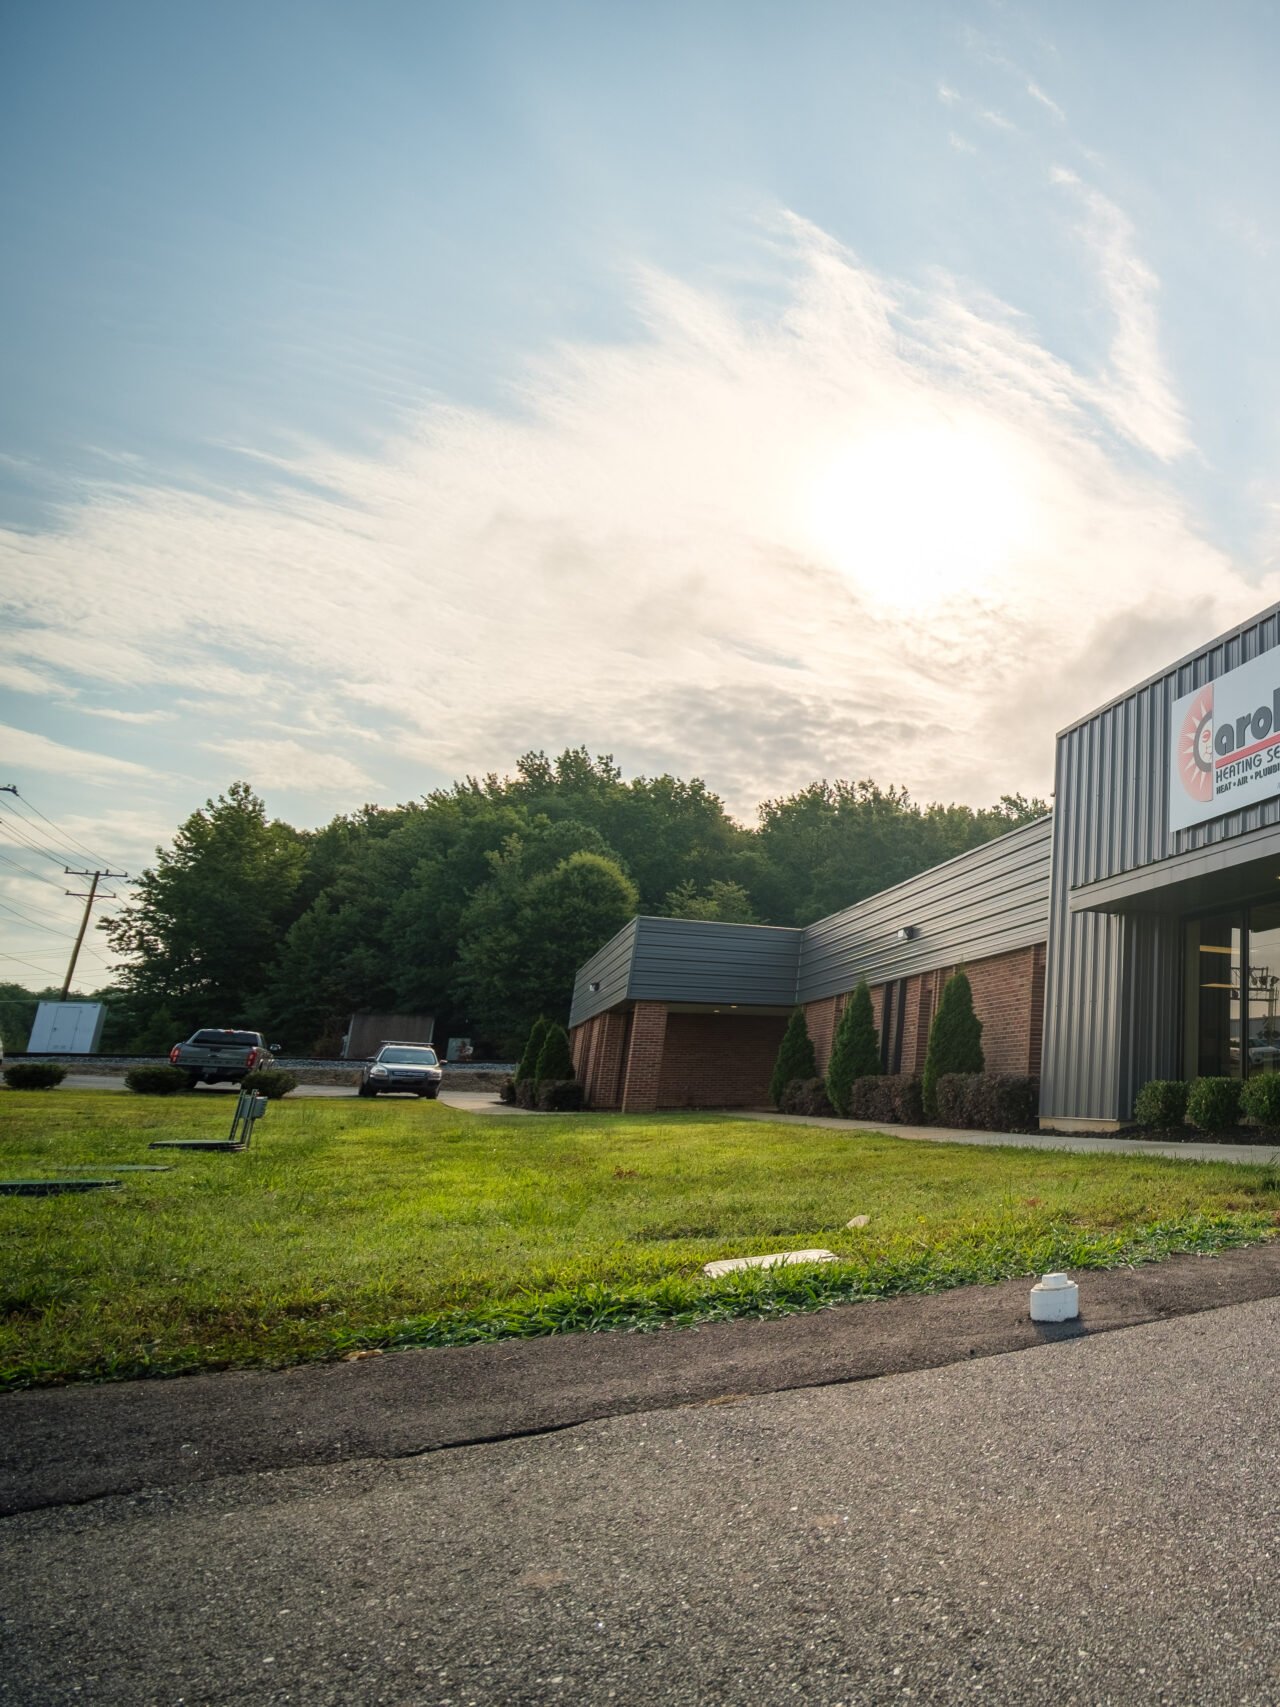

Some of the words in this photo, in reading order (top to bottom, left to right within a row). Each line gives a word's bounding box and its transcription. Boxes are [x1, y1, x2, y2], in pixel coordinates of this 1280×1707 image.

[1216, 754, 1263, 783] HEATING
[1216, 781, 1232, 795] HEAT
[1237, 775, 1249, 787] AIR
